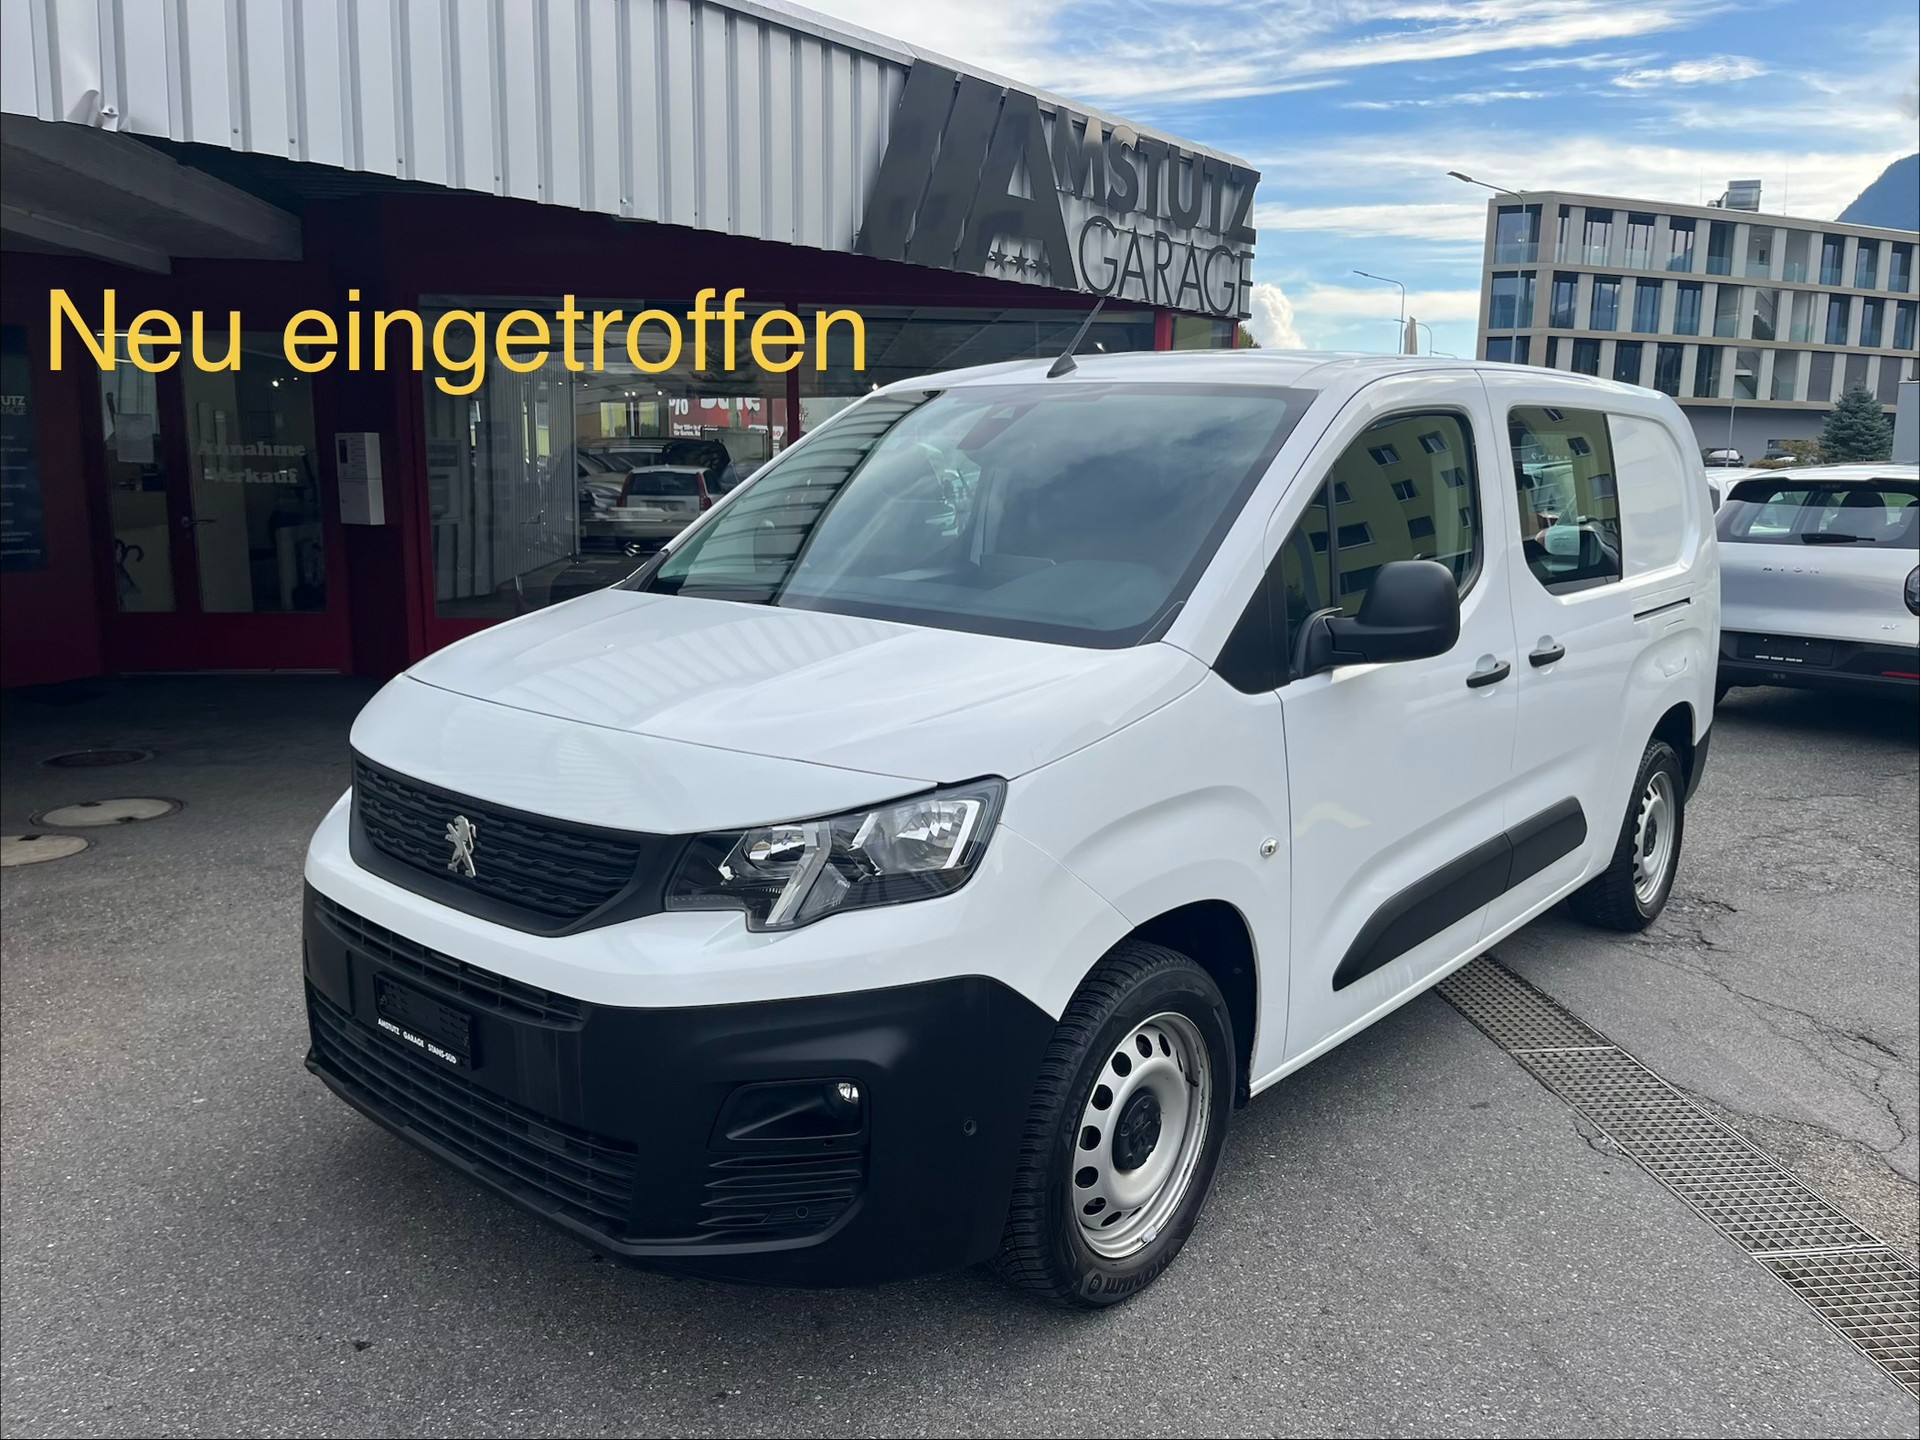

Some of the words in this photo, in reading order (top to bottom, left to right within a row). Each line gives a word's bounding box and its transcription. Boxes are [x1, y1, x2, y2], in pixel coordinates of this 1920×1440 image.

[955, 87, 1261, 289] AMSTUTZ
[1078, 214, 1256, 320] GARAGE
[402, 1031, 424, 1047] GARAGE
